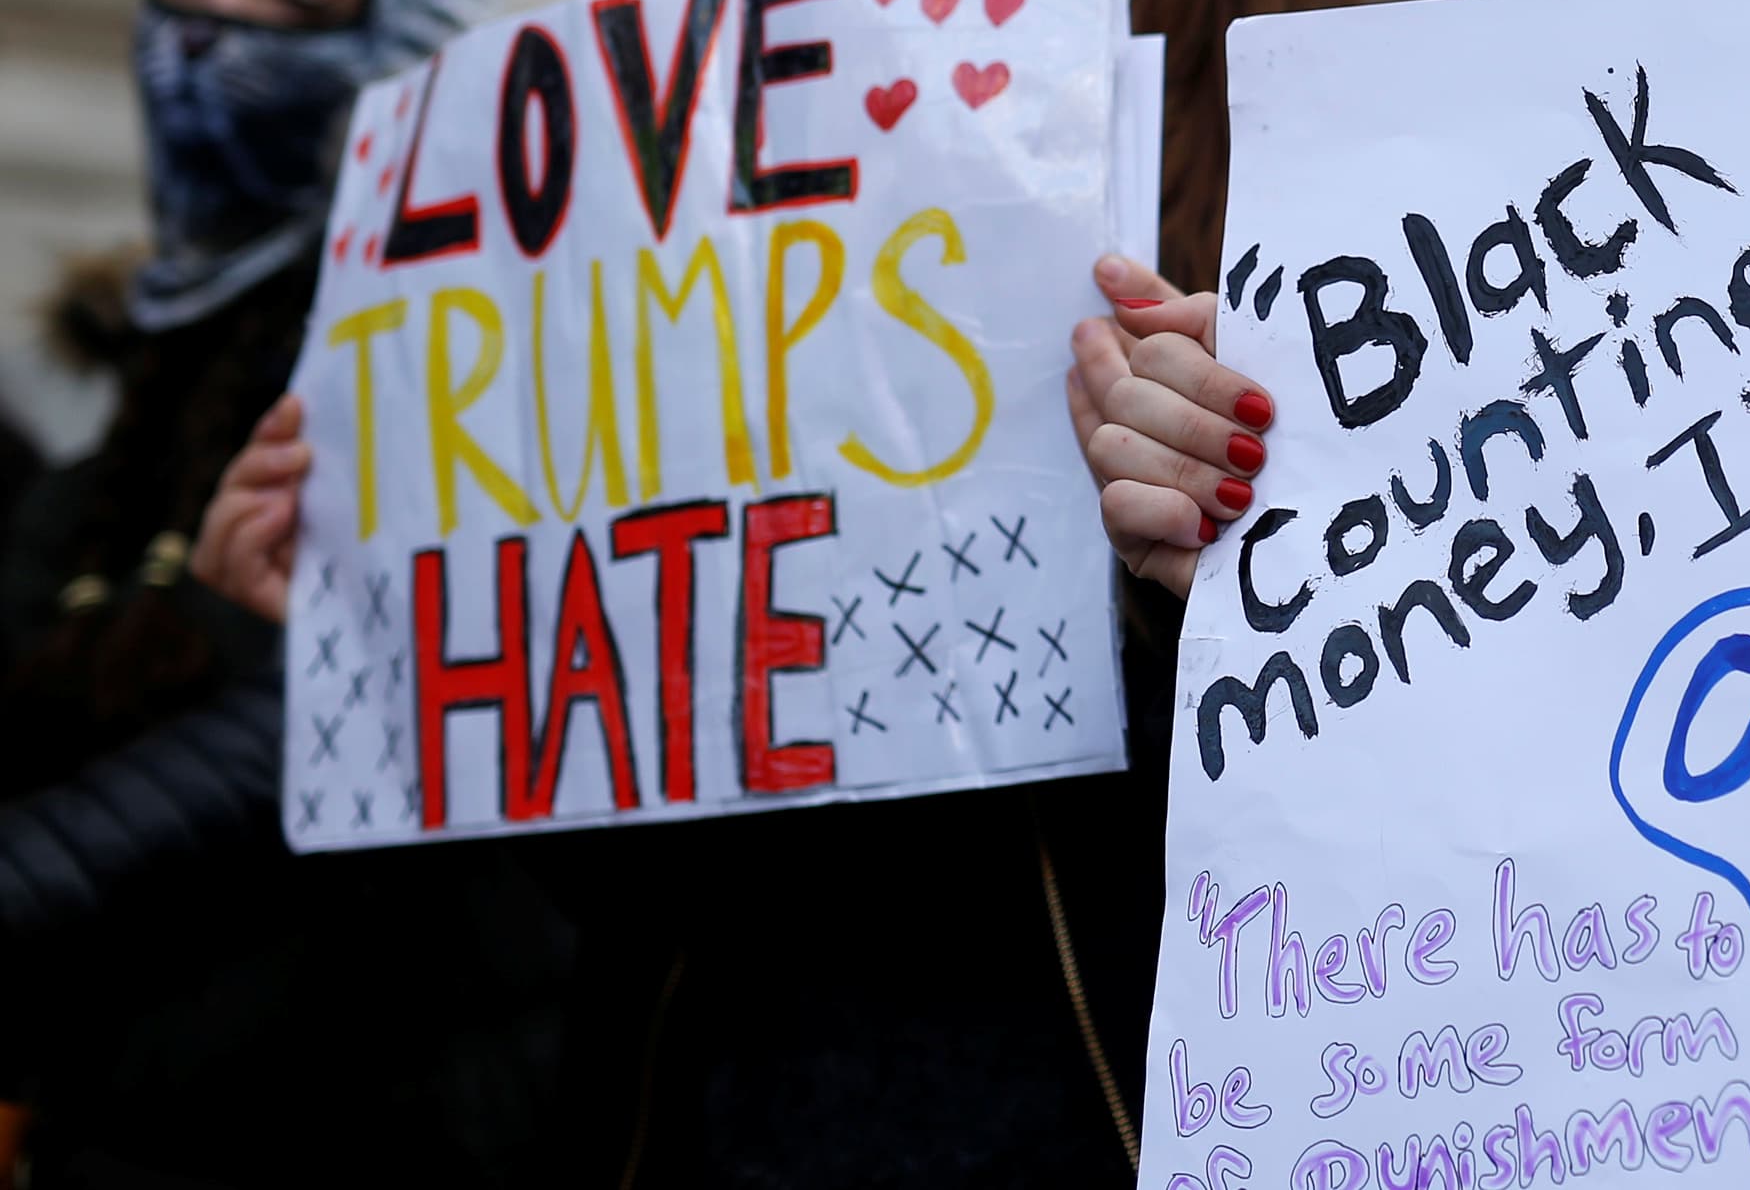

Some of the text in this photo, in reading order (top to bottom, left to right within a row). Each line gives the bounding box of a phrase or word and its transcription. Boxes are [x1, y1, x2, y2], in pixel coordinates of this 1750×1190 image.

[327, 207, 995, 542] TRUMPS
[1225, 59, 1742, 429] "Black
[411, 488, 837, 832] HATE
[1169, 992, 1739, 1138] be some form
[1493, 856, 1659, 983] has
[1675, 891, 1745, 981] to
